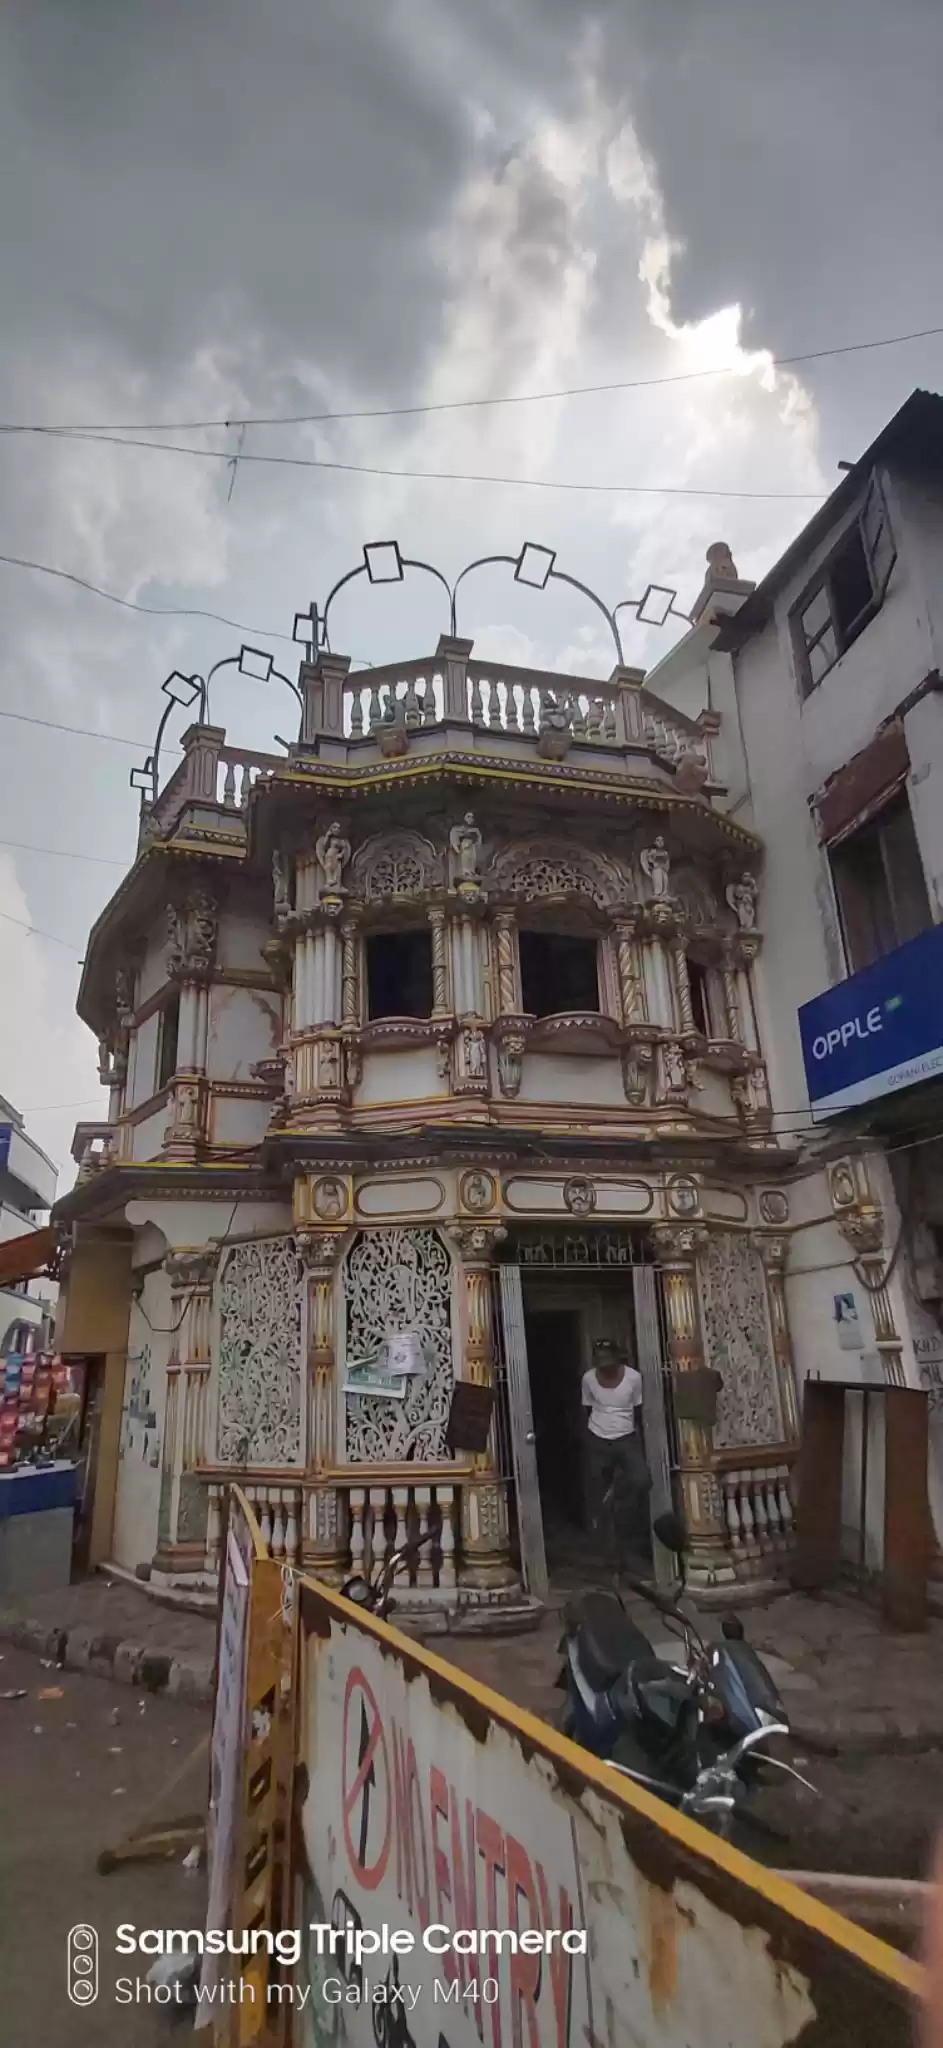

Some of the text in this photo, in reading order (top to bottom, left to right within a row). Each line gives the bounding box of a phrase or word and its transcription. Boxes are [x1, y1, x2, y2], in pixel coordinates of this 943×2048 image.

[812, 1006, 883, 1060] OPPLE
[390, 1714, 573, 2048] NO ENTRY
